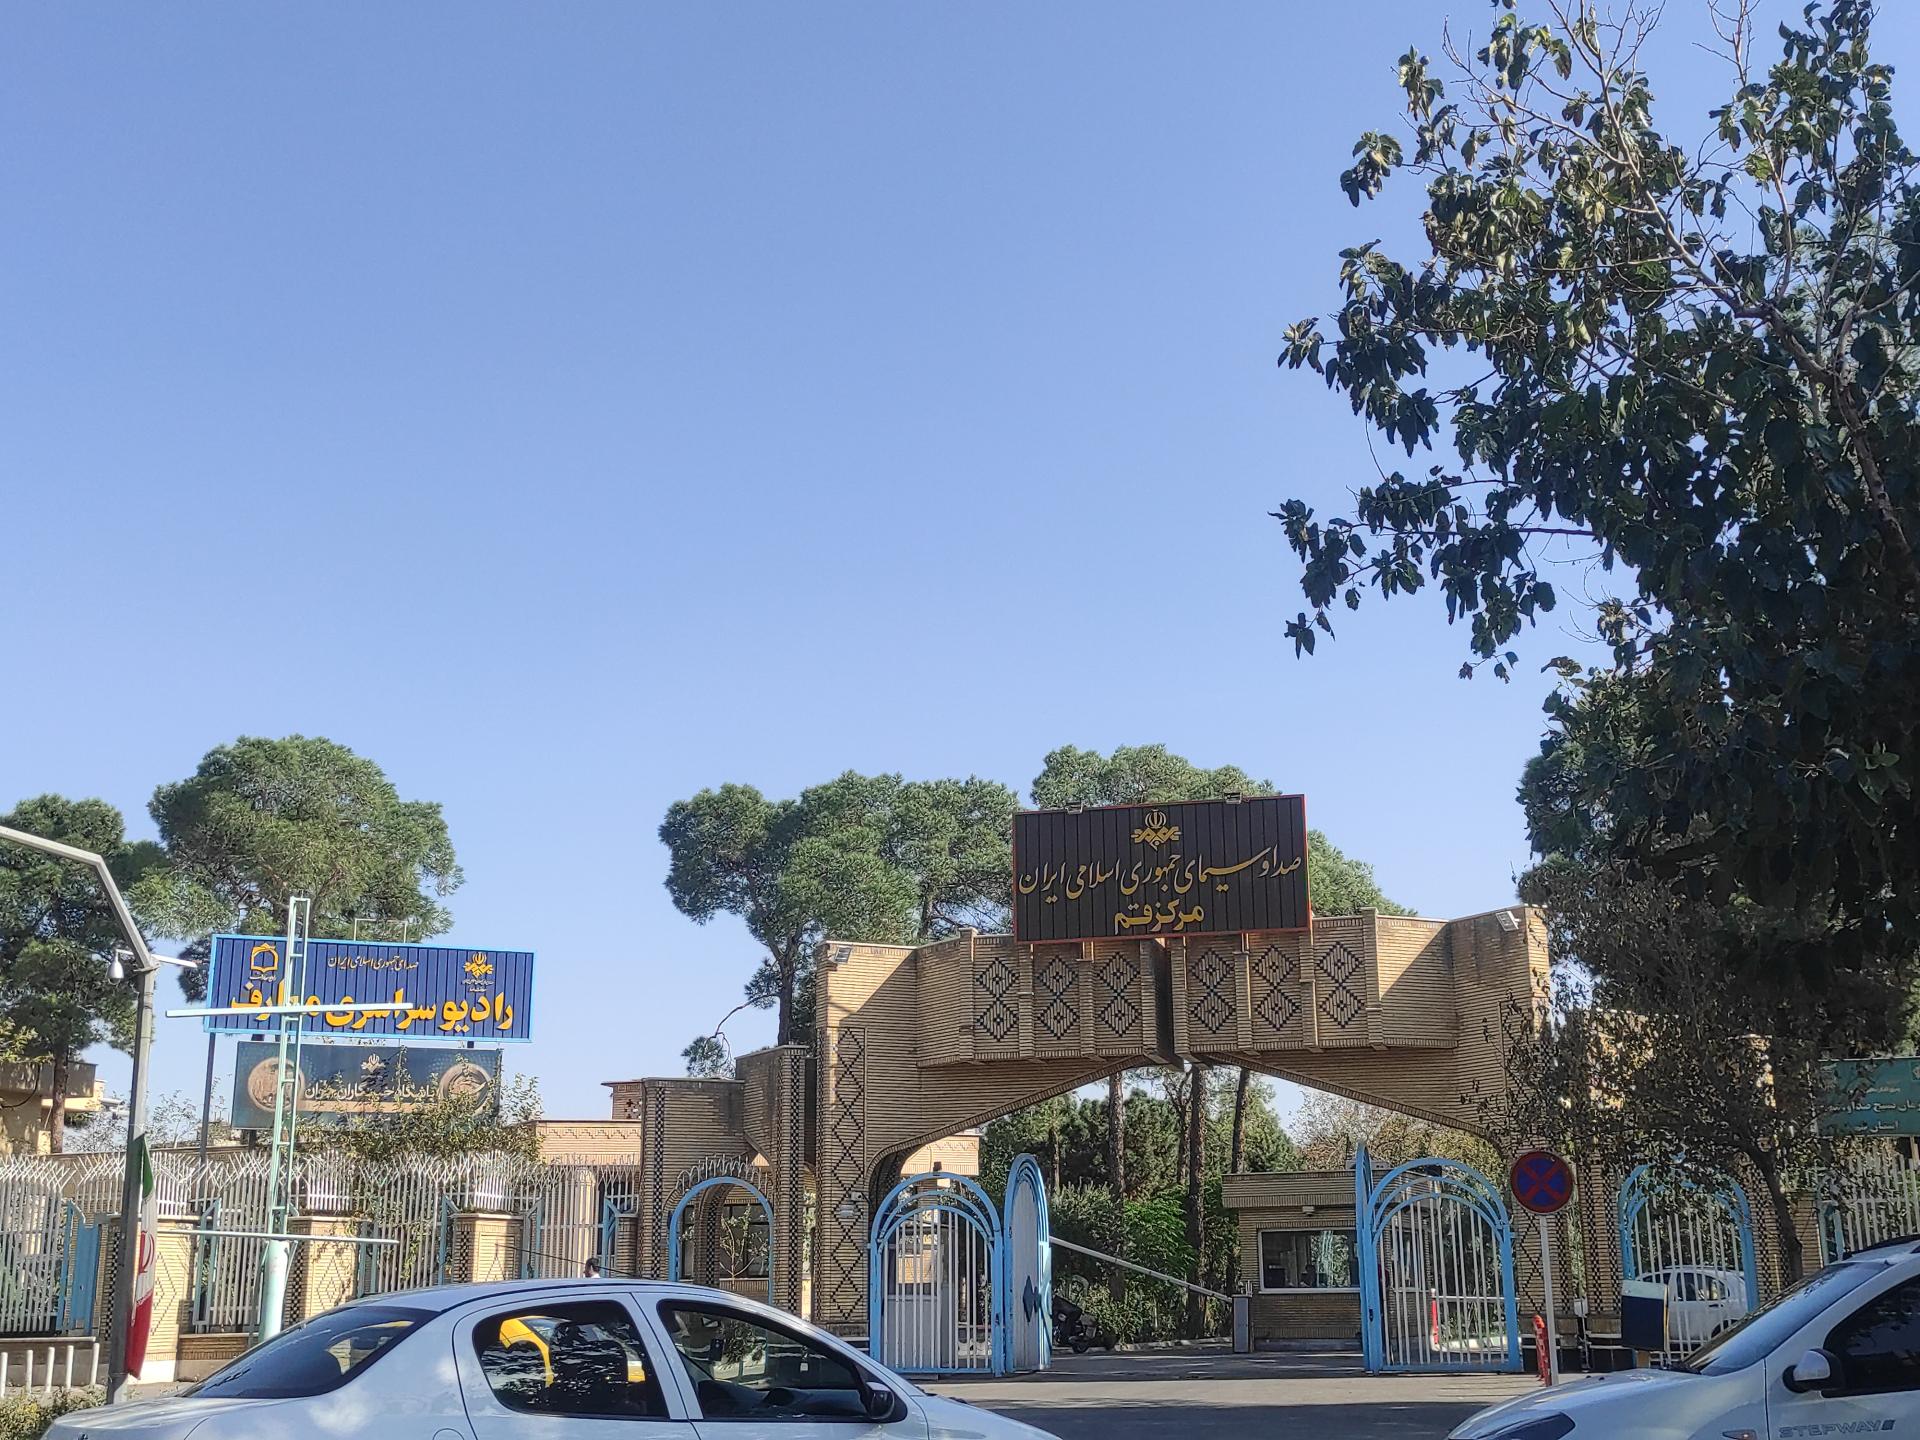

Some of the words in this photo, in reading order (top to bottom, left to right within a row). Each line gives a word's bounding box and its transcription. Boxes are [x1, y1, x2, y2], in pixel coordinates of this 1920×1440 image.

[1018, 861, 1066, 903] ایران
[1066, 858, 1121, 899] اسلامی
[1120, 854, 1181, 896] جمهوری
[1174, 847, 1271, 893] سیمای
[1114, 902, 1154, 935] قم
[1149, 899, 1205, 932] مرکز
[327, 956, 350, 970] ایران
[350, 955, 373, 969] اسلامی
[373, 955, 401, 971] جمهوری
[394, 959, 419, 971] صدای
[325, 988, 437, 1029] سراسری
[438, 991, 514, 1033] رادیو
[1779, 1419, 1881, 1438] STEPWAY
